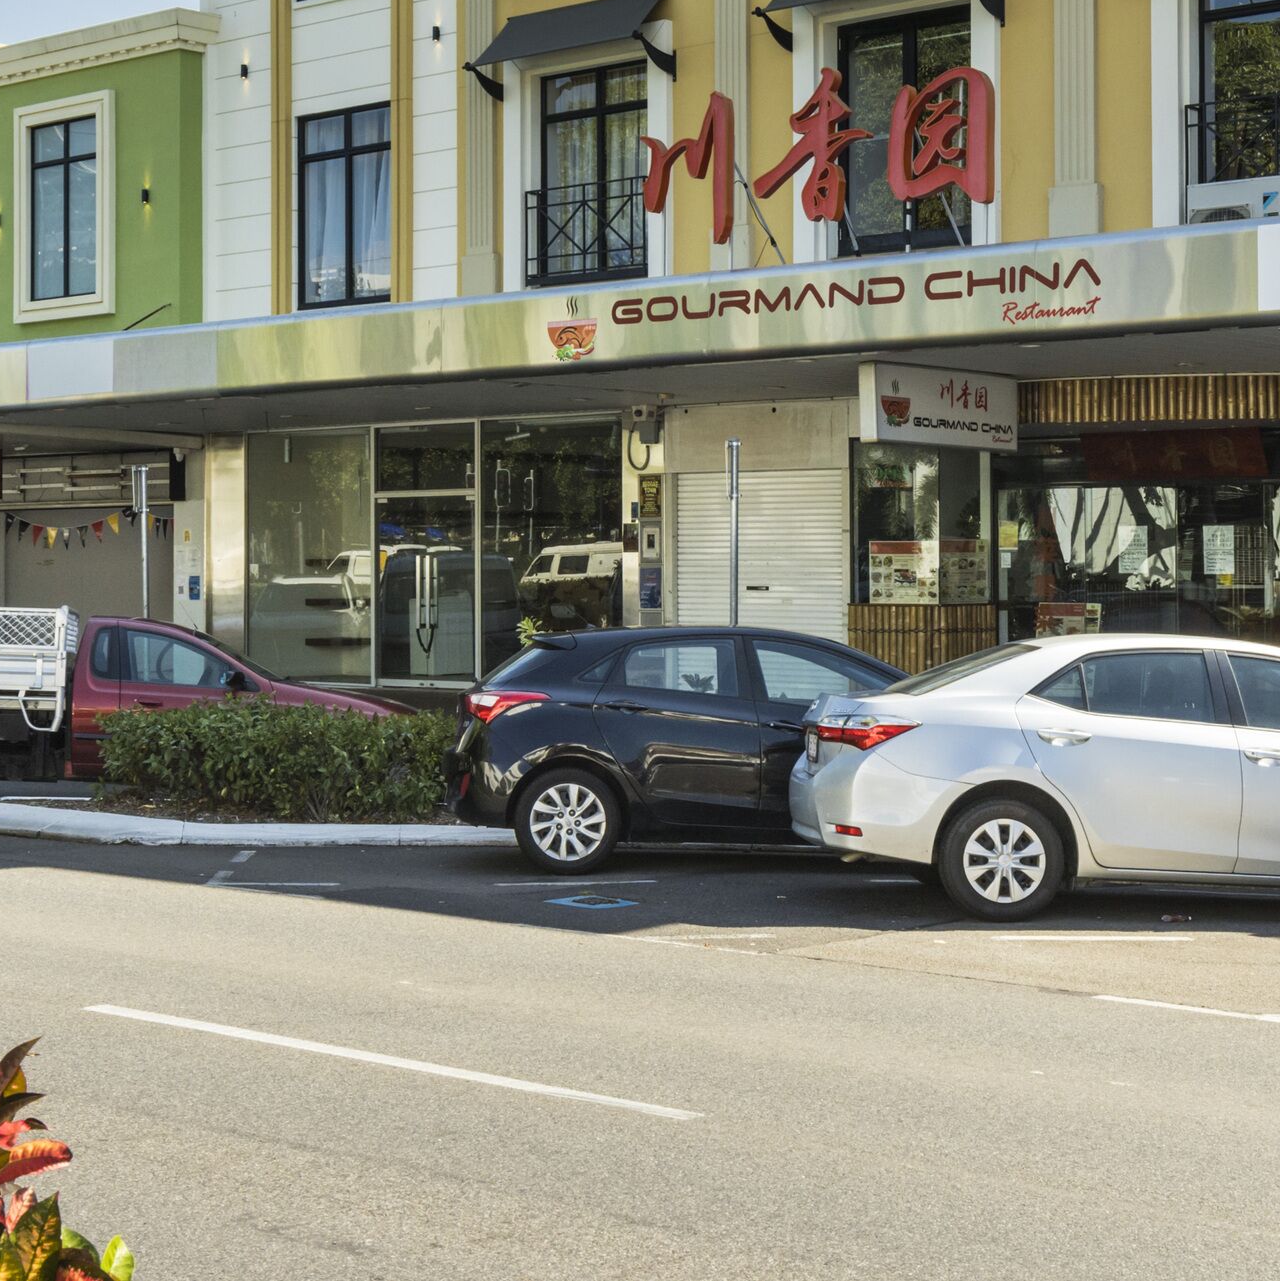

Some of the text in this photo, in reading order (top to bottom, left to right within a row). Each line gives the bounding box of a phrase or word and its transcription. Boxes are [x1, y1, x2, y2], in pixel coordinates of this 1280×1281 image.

[611, 258, 1102, 325] GOURMAND CHINA
[1002, 296, 1102, 325] Restaurant
[913, 417, 1013, 435] GOURMAND CHINA
